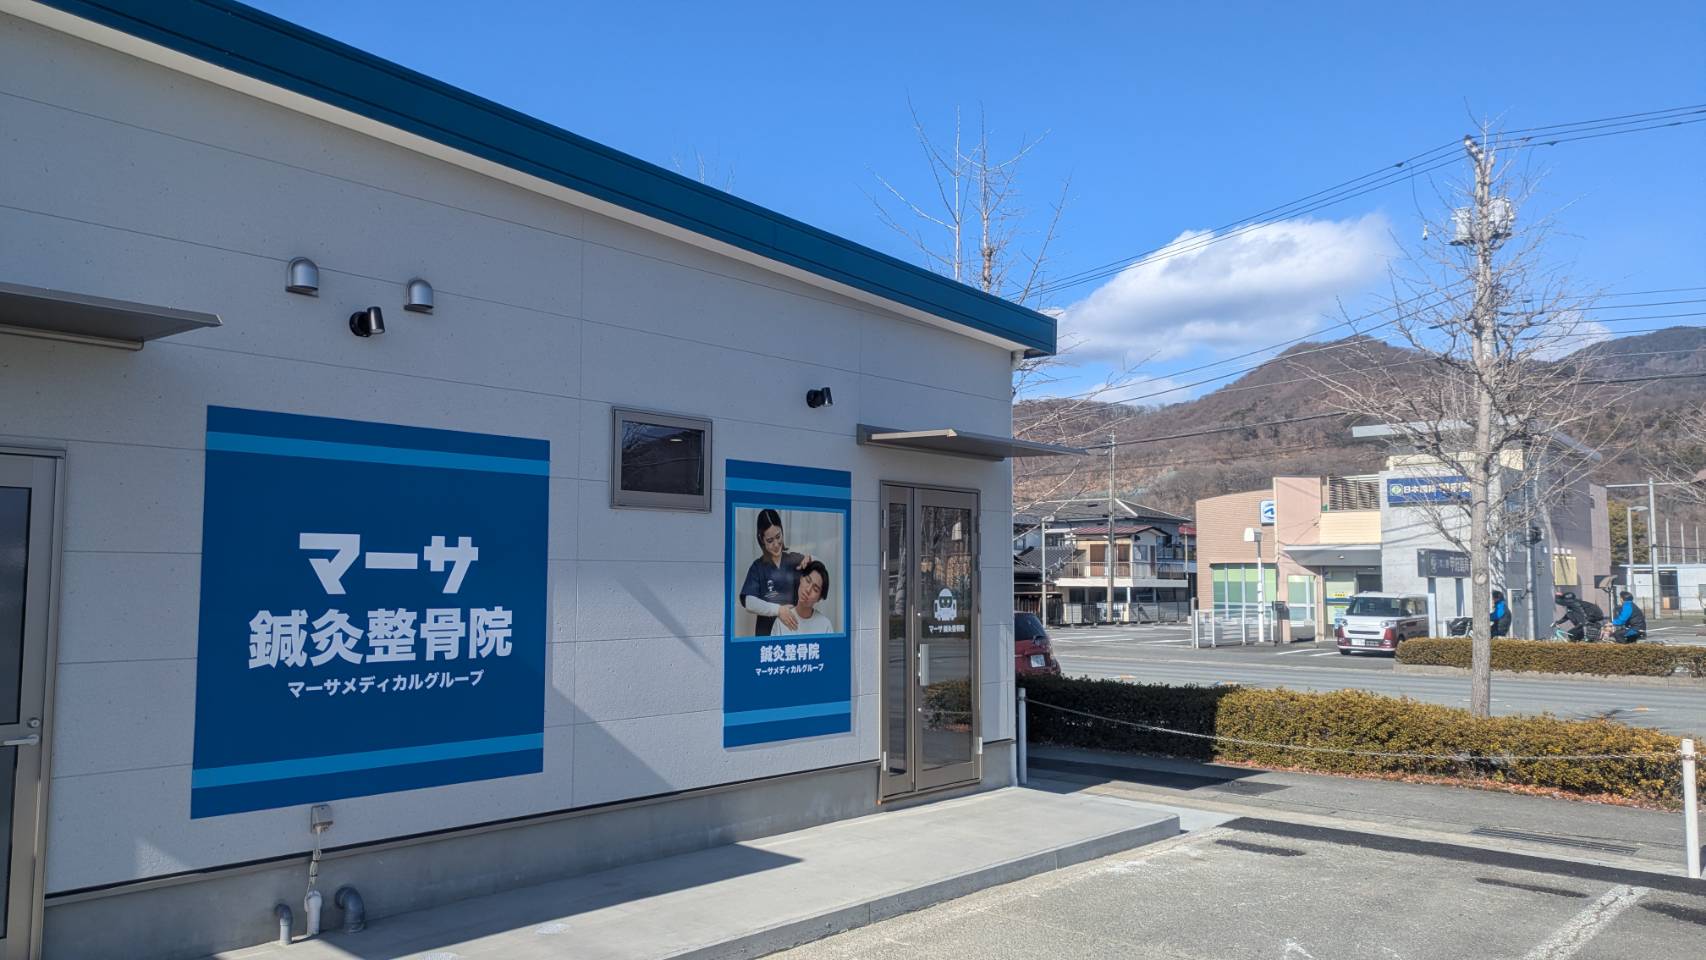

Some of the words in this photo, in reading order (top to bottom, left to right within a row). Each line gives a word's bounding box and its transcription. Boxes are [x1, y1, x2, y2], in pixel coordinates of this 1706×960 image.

[300, 533, 478, 594] マーサ
[249, 606, 512, 669] 鍼灸整骨院
[760, 642, 820, 663] マーサメディカルグループ
[761, 643, 819, 662] 鍼灸整骨院
[288, 669, 484, 698] マーサメディカルグループ
